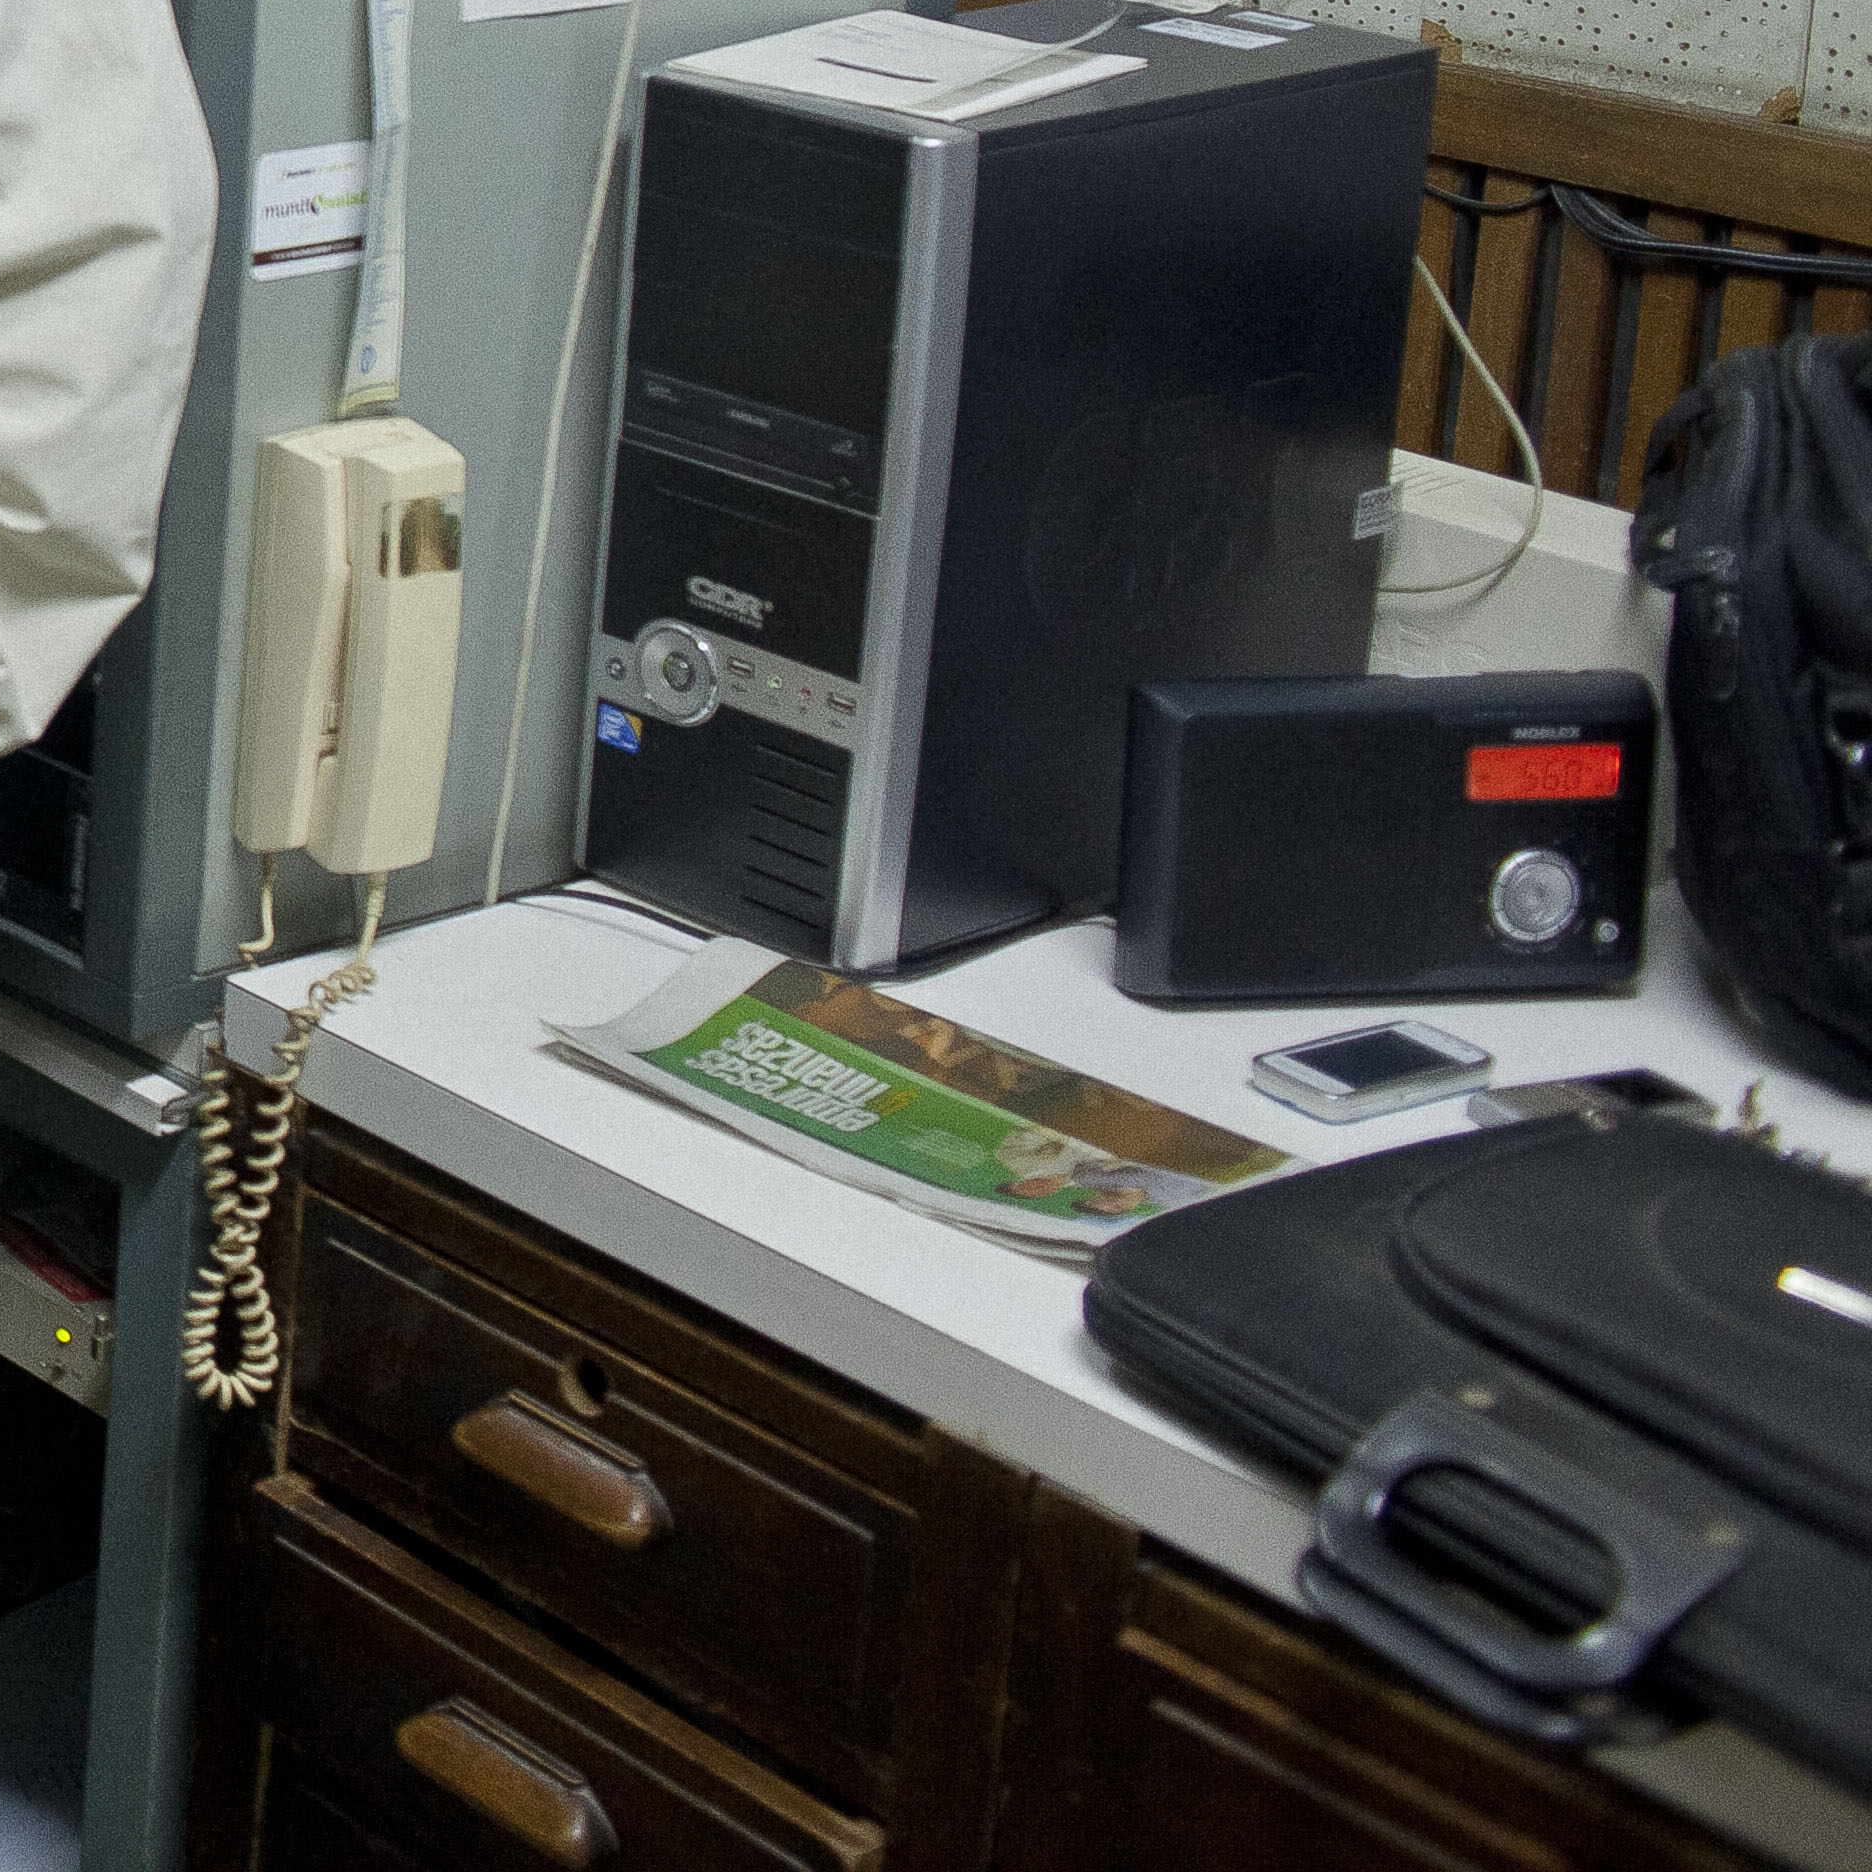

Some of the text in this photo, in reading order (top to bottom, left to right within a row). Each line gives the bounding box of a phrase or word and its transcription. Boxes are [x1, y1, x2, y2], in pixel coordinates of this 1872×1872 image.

[1513, 727, 1581, 740] NOBLEX
[685, 1048, 881, 1132] empresas
[721, 1020, 891, 1108] finanzas
